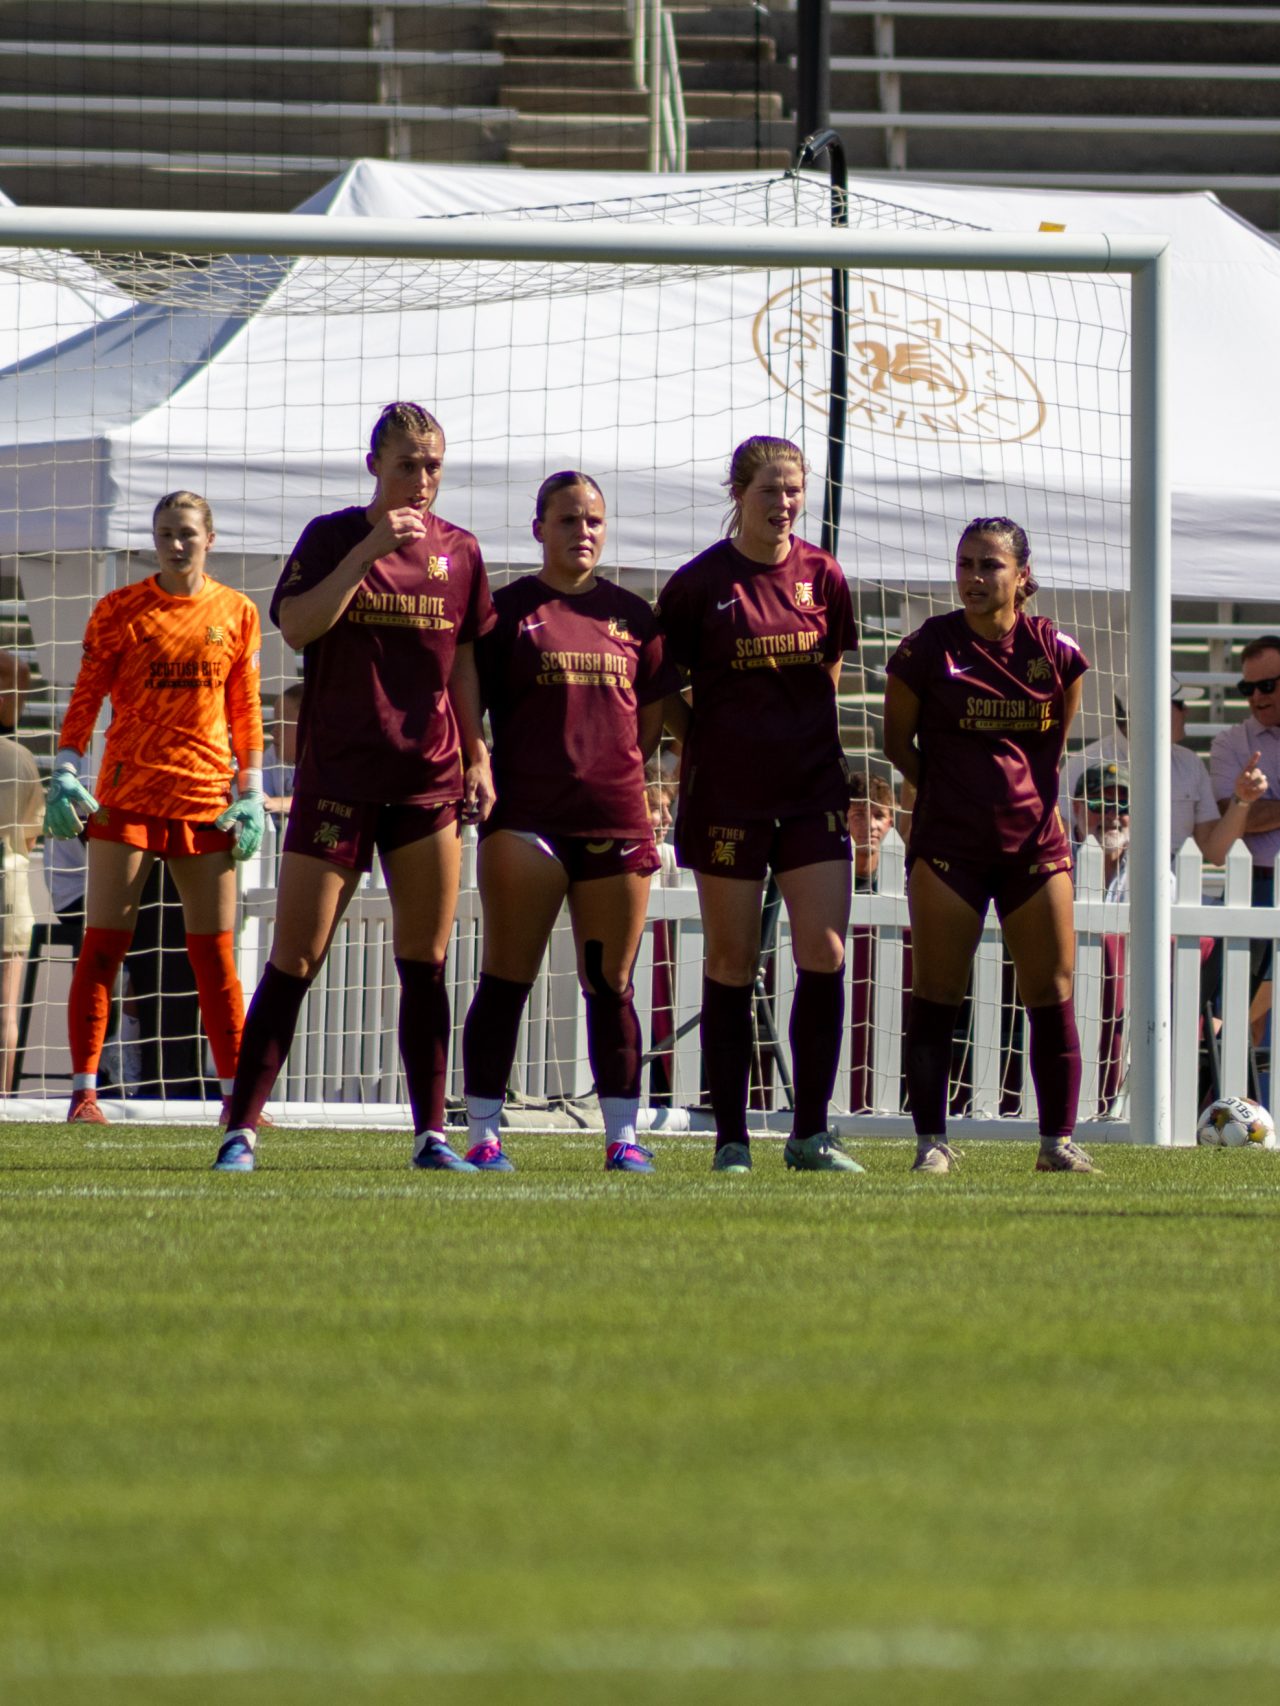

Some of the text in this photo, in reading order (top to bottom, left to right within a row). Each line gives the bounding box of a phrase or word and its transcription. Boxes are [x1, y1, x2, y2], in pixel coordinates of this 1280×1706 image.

[774, 290, 992, 358] DALLAS
[356, 590, 445, 616] SCOTTISH RITE
[736, 630, 820, 658] SCOTTISH RITE
[541, 651, 628, 674] SCOTTISH RITE
[966, 697, 1053, 720] SCOTTISH RITE
